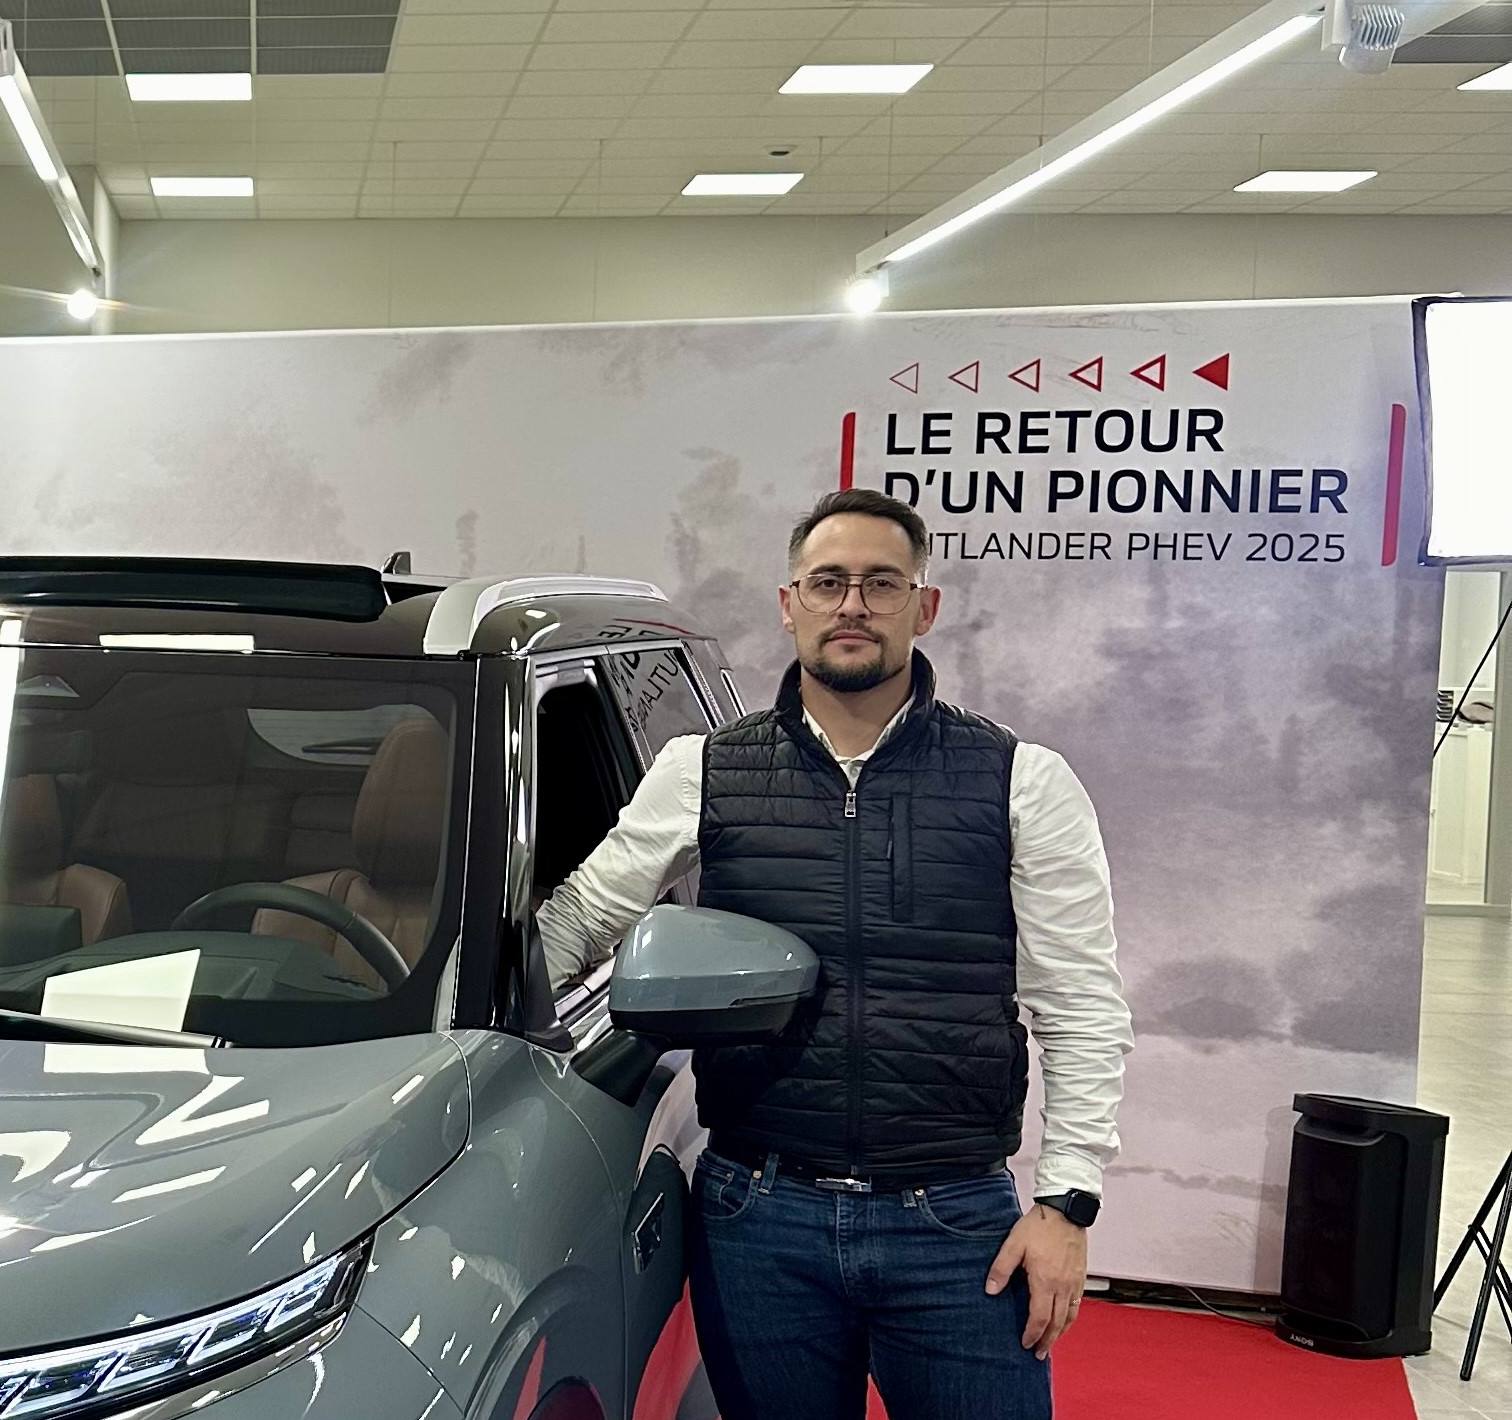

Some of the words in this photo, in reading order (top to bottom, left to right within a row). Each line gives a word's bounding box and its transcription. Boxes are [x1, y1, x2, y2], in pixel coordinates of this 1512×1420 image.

[886, 412, 953, 456] LE
[975, 408, 1225, 455] RETOUR
[885, 469, 1024, 514] D'UN
[1047, 468, 1349, 514] PIONNIER
[928, 532, 1112, 561] TLANDER
[1127, 532, 1233, 561] PHEV
[1245, 532, 1345, 563] 2025
